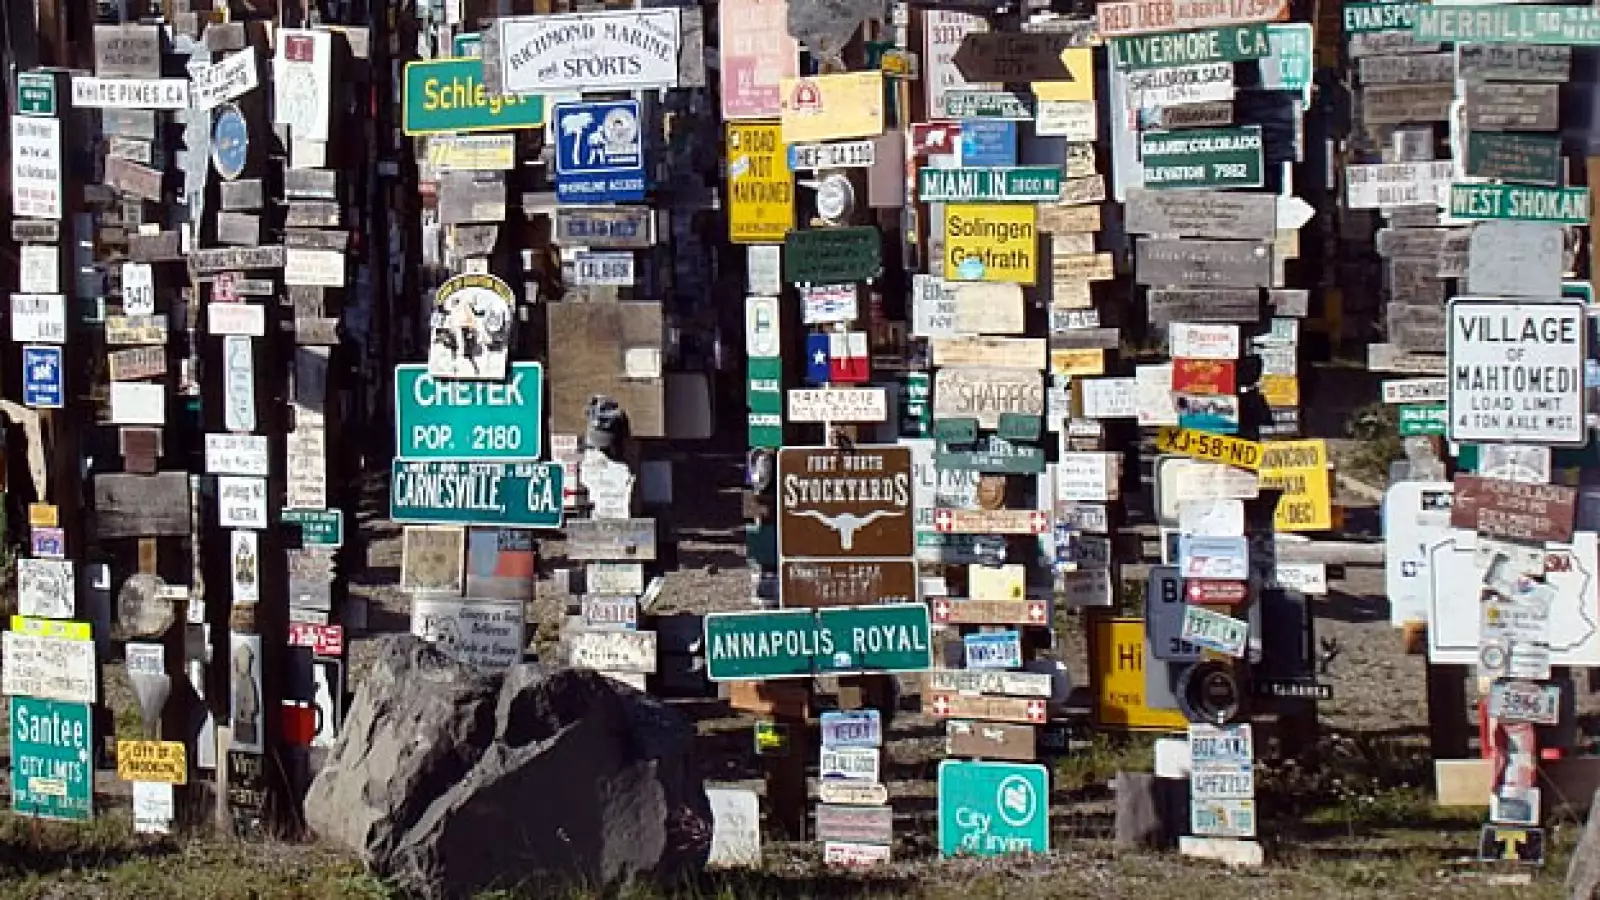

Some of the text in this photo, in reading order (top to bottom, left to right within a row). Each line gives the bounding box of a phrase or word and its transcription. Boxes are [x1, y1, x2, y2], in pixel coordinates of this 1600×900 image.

[1419, 10, 1534, 37] MERRILL
[510, 24, 597, 70] RICHMOND
[604, 22, 671, 61] MARINE
[1113, 29, 1268, 67] LIVERMORE CA
[563, 55, 642, 80] SPORTS
[77, 82, 117, 101] WHITE
[743, 131, 776, 152] ROAD
[748, 156, 773, 178] NOT
[733, 182, 790, 204] MAINTAINED
[1453, 188, 1590, 219] WEST SHOKAN
[948, 214, 1032, 244] Solingen
[1458, 315, 1576, 344] VILLAGE
[1506, 348, 1525, 362] OF
[413, 372, 524, 406] CHETEK
[1456, 366, 1578, 393] MAHTOMEDI
[1471, 396, 1562, 411] LOAD LIMIT
[1474, 415, 1500, 429] TON
[412, 424, 522, 450] POP. 2180
[784, 473, 909, 508] STOCKYARDS
[712, 624, 928, 661] ANNAPOLIS ROYAL
[17, 704, 84, 748] Santee
[19, 755, 45, 777] CITY
[955, 806, 991, 834] City
[1495, 830, 1527, 860] T
